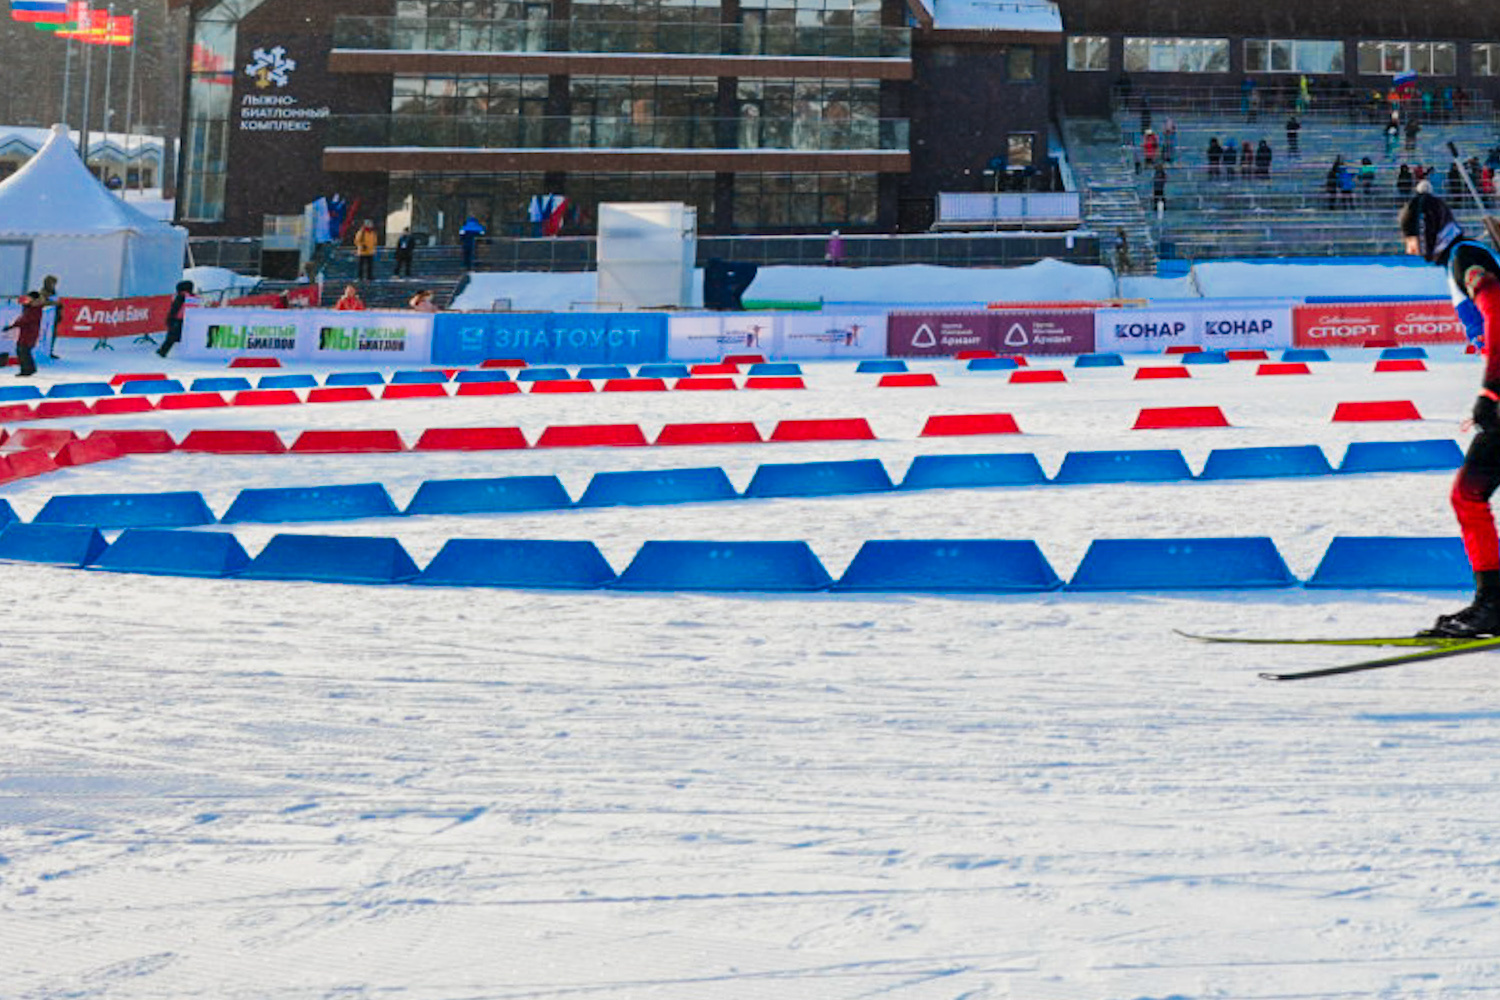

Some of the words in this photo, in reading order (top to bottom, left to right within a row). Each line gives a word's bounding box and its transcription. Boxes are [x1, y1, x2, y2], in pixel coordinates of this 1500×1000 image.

[242, 94, 297, 105] ЛЫЖНО-
[241, 106, 330, 118] БИАТЛОННЫЙ
[240, 120, 312, 131] КОМПЛЕКС
[75, 305, 125, 328] Альфа
[1115, 322, 1186, 338] КОНАР
[1205, 319, 1273, 335] КОНАР
[1308, 324, 1380, 338] СПОРТ
[495, 329, 641, 347] ЗЛАТОУСТ
